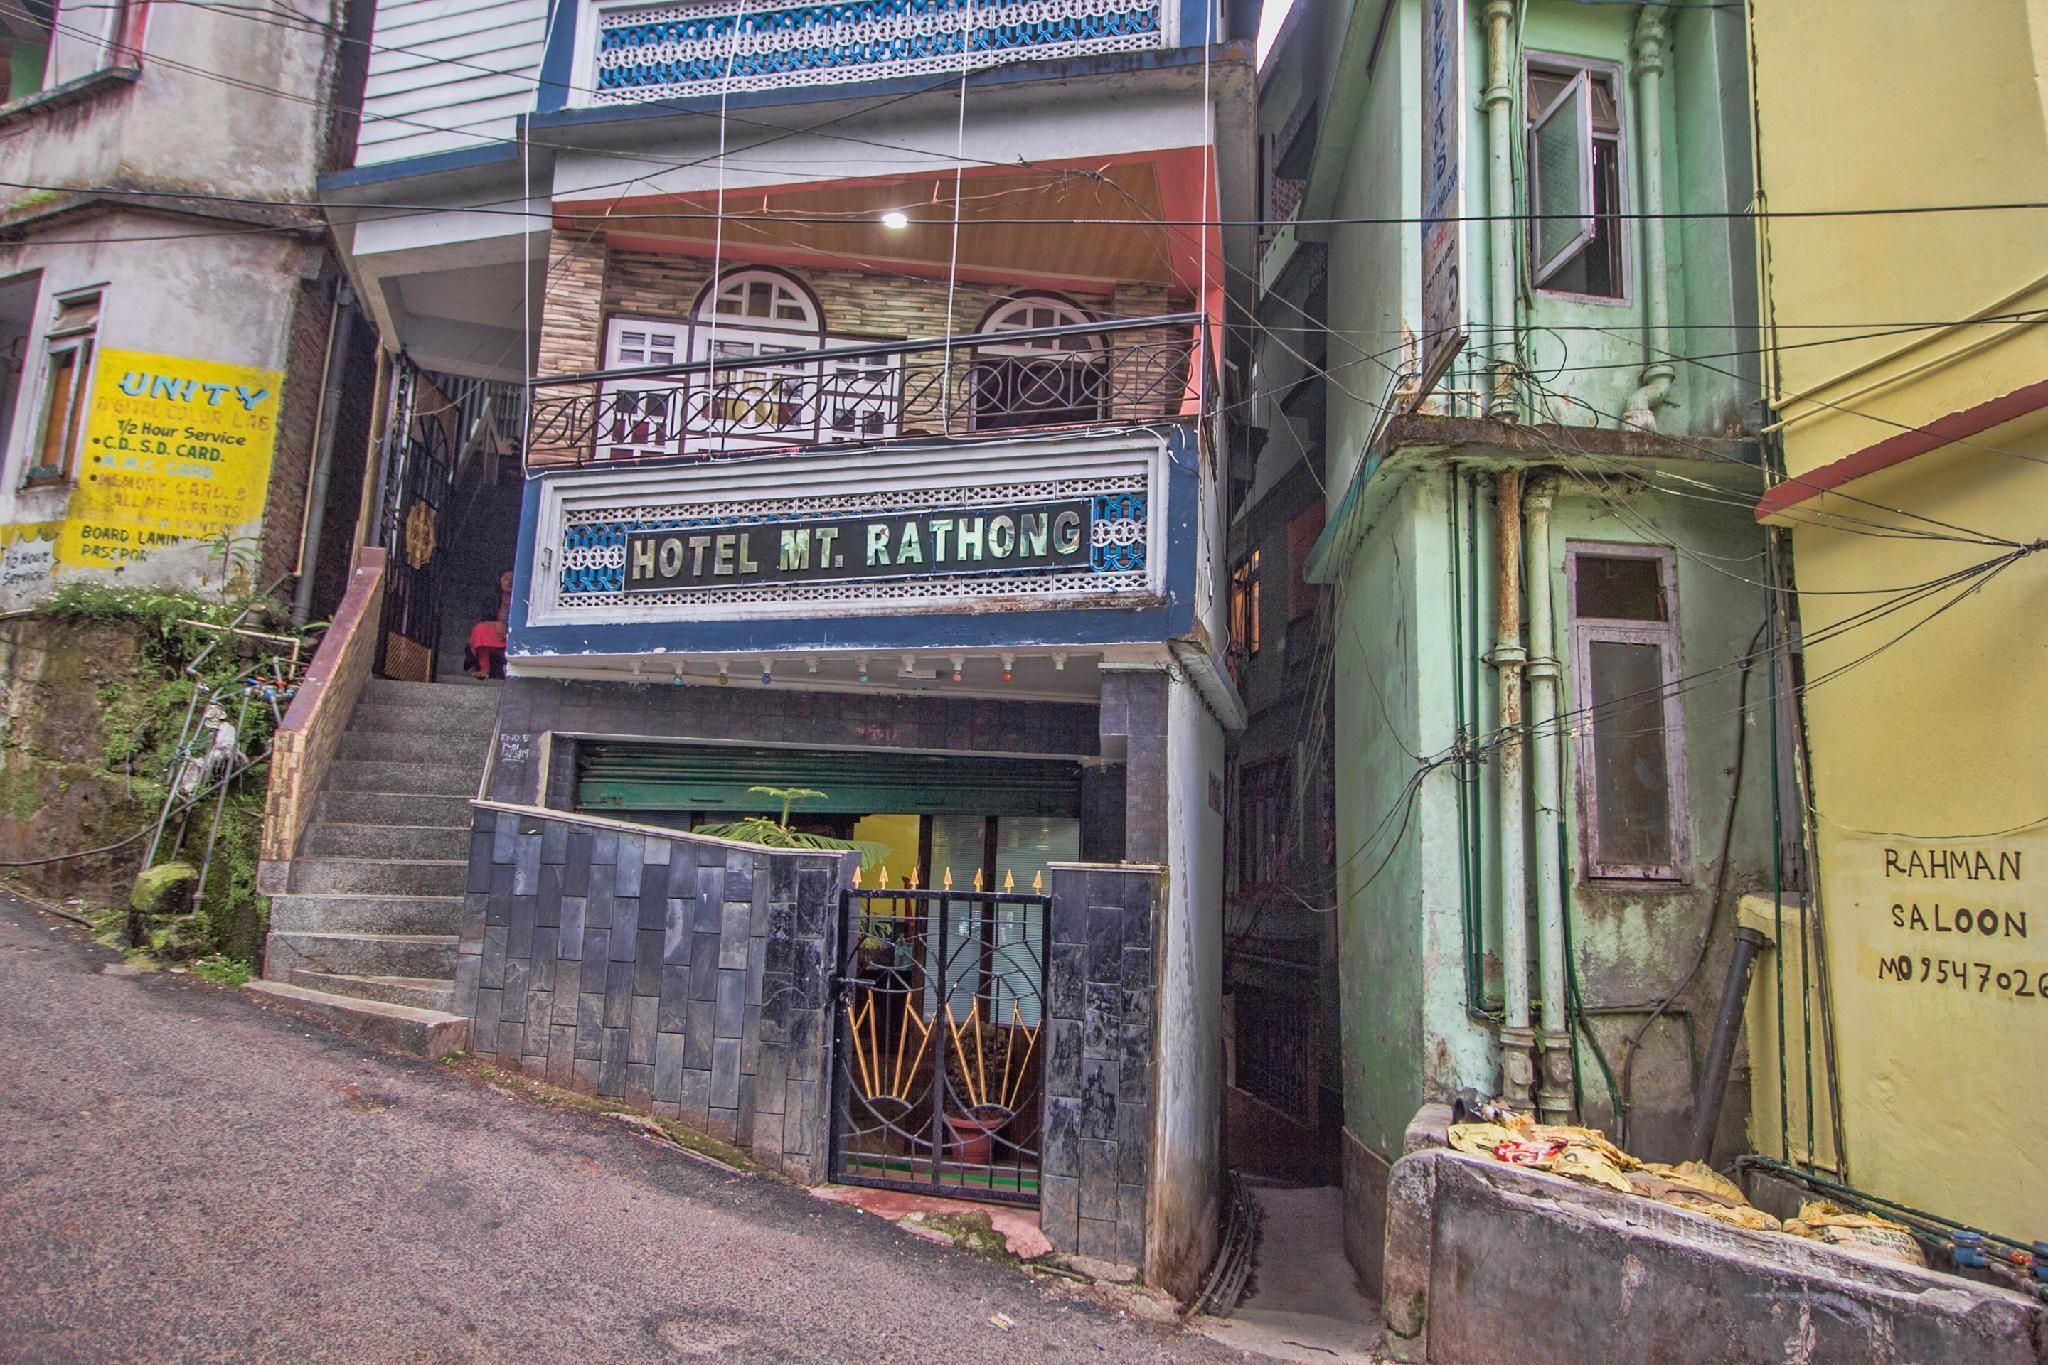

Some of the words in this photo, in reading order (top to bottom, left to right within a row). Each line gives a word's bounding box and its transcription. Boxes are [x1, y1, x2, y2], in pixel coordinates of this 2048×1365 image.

[118, 371, 269, 411] UNITY
[97, 396, 160, 418] DGITAL
[232, 411, 271, 432] LAB
[117, 418, 138, 435] 1/2
[141, 422, 178, 438] Hour
[184, 426, 247, 446] Service
[81, 525, 130, 542] BOARD
[632, 533, 758, 580] HOTEL
[779, 527, 845, 571] MT.
[866, 510, 1082, 567] RATHONG
[80, 545, 155, 562] PASPOR
[1884, 848, 2022, 881] RAHMAN
[1891, 903, 2028, 938] SALOON
